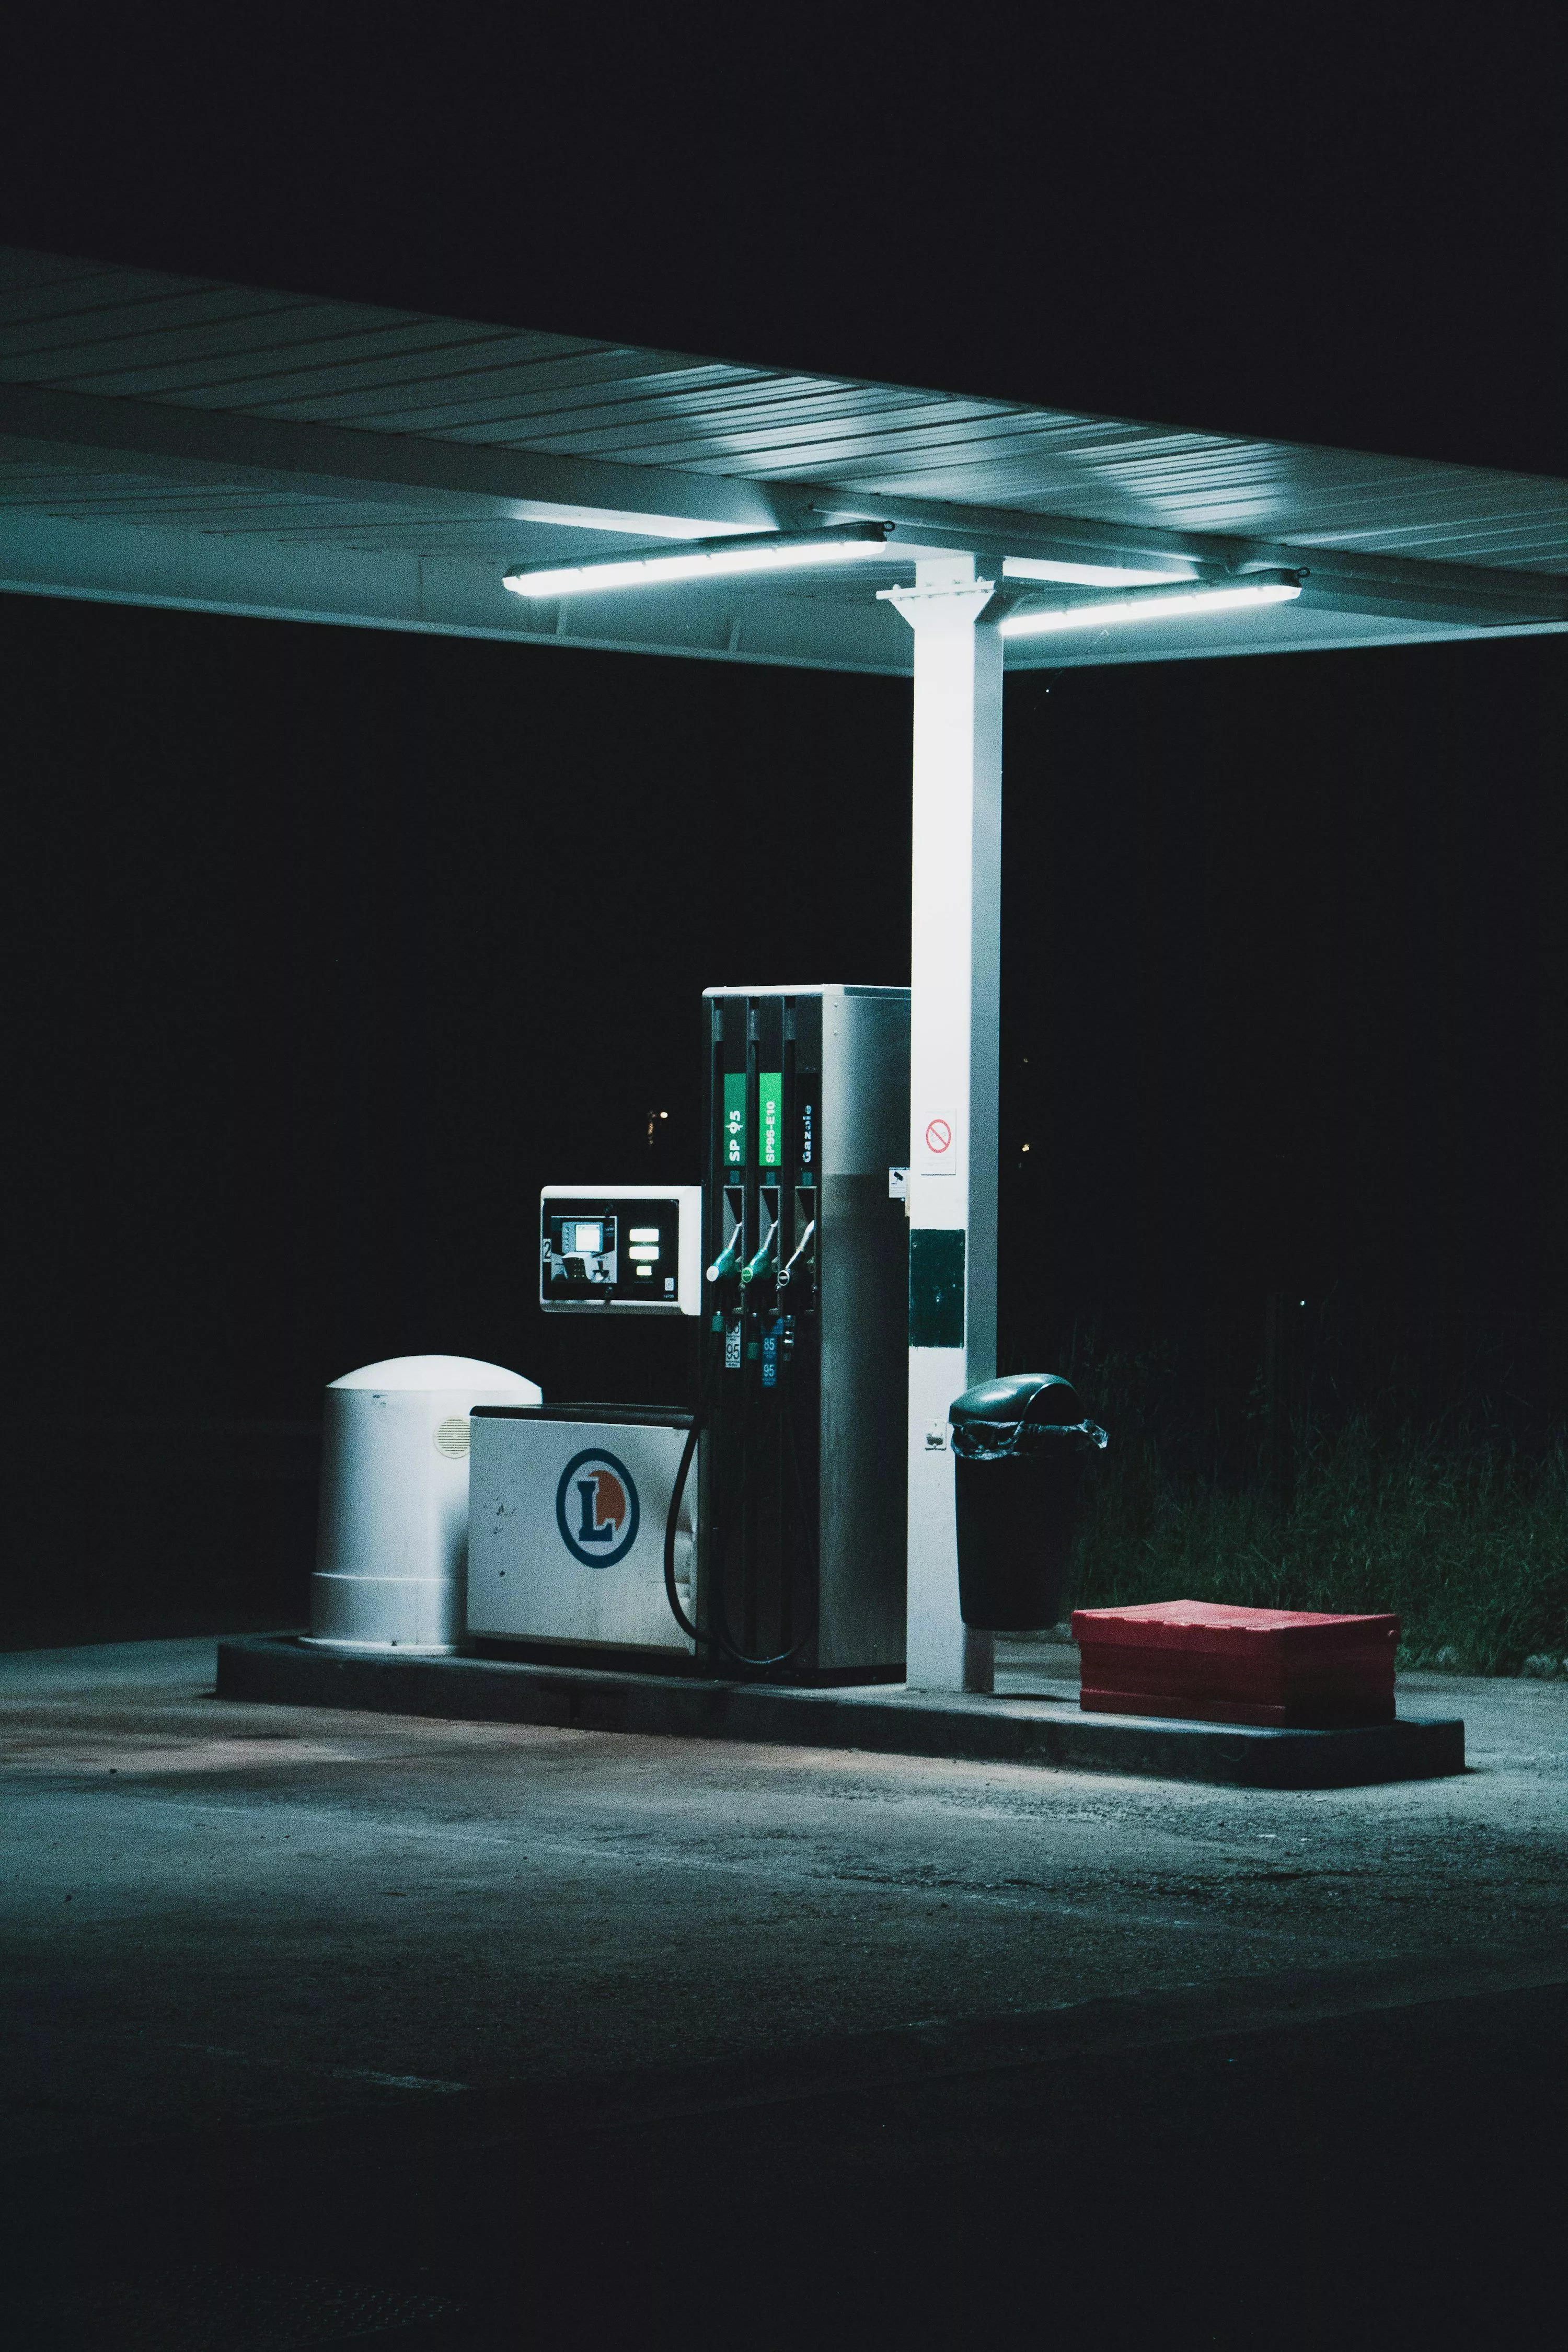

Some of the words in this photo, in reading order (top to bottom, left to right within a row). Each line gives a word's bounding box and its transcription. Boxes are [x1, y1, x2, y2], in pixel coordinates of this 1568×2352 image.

[766, 1101, 775, 1163] SP95-E10
[802, 1105, 812, 1163] Gazole
[729, 1139, 740, 1161] SP
[544, 1240, 552, 1259] 2
[727, 1343, 740, 1359] 95
[764, 1364, 775, 1377] 95
[577, 1481, 613, 1542] L
